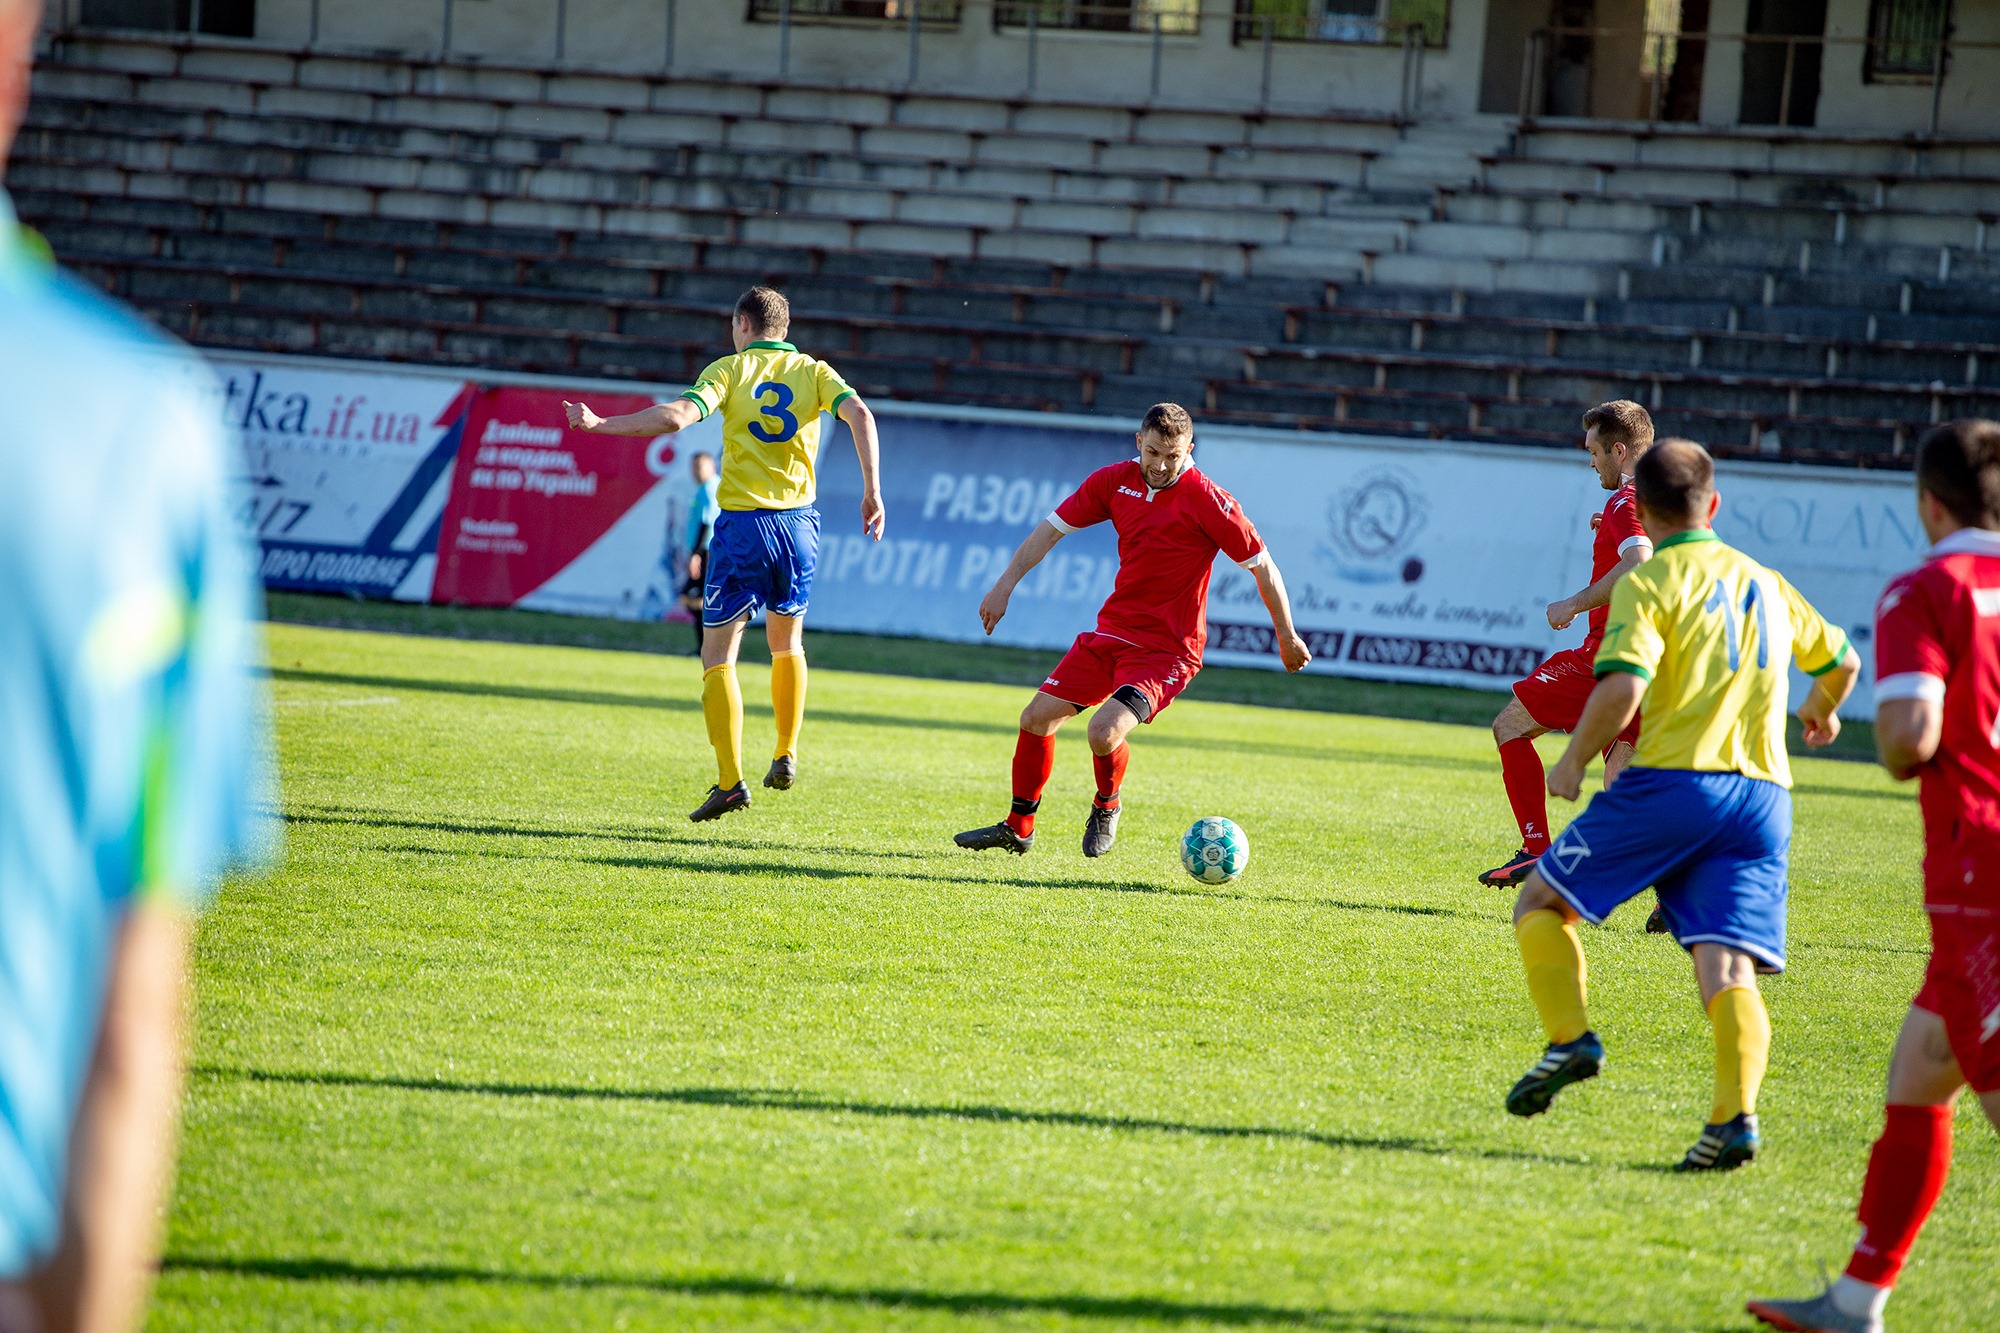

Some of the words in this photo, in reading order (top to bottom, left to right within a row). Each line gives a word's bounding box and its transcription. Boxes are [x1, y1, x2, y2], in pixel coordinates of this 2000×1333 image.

[222, 371, 420, 444] tka.if.ua
[748, 382, 798, 442] 3
[1117, 485, 1143, 498] Zeus
[1706, 579, 1767, 671] 11
